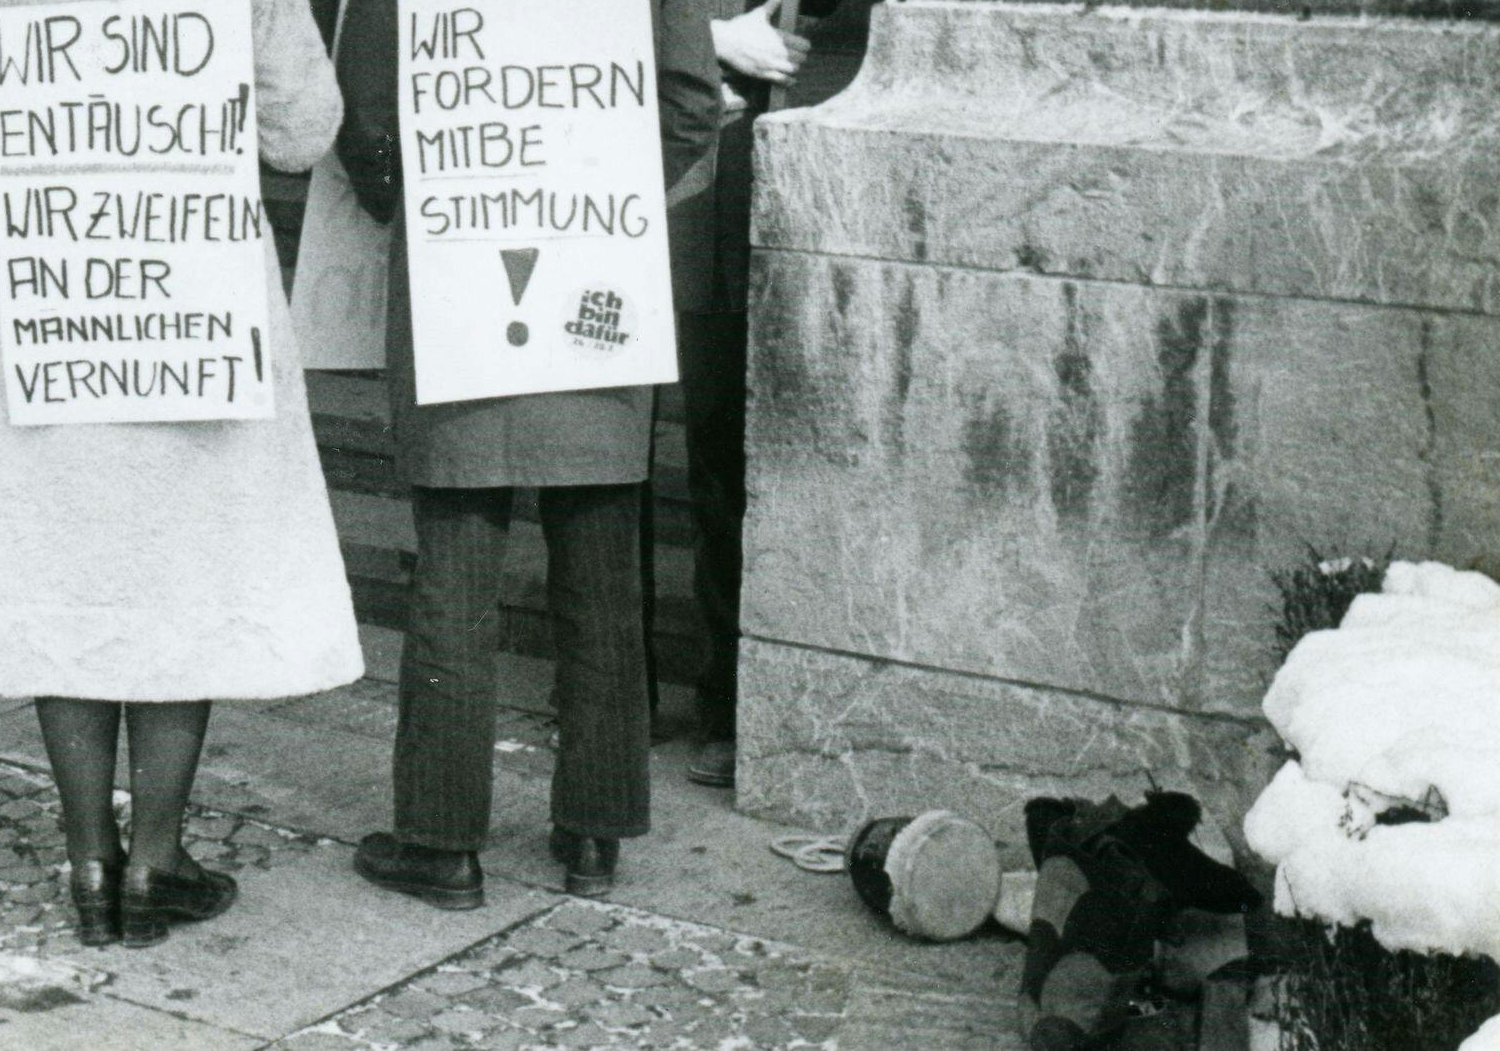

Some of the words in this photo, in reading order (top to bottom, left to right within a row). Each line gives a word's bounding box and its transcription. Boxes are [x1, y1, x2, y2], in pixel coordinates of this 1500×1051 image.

[101, 12, 215, 77] SIND
[410, 7, 485, 62] WIR
[411, 60, 646, 114] FORDERN
[416, 122, 547, 174] MITBE
[4, 186, 79, 241] WIR
[85, 191, 262, 244] ZWEIFELN
[420, 188, 649, 239] STIMMUNG
[8, 257, 69, 300] AN
[85, 257, 173, 300] DER
